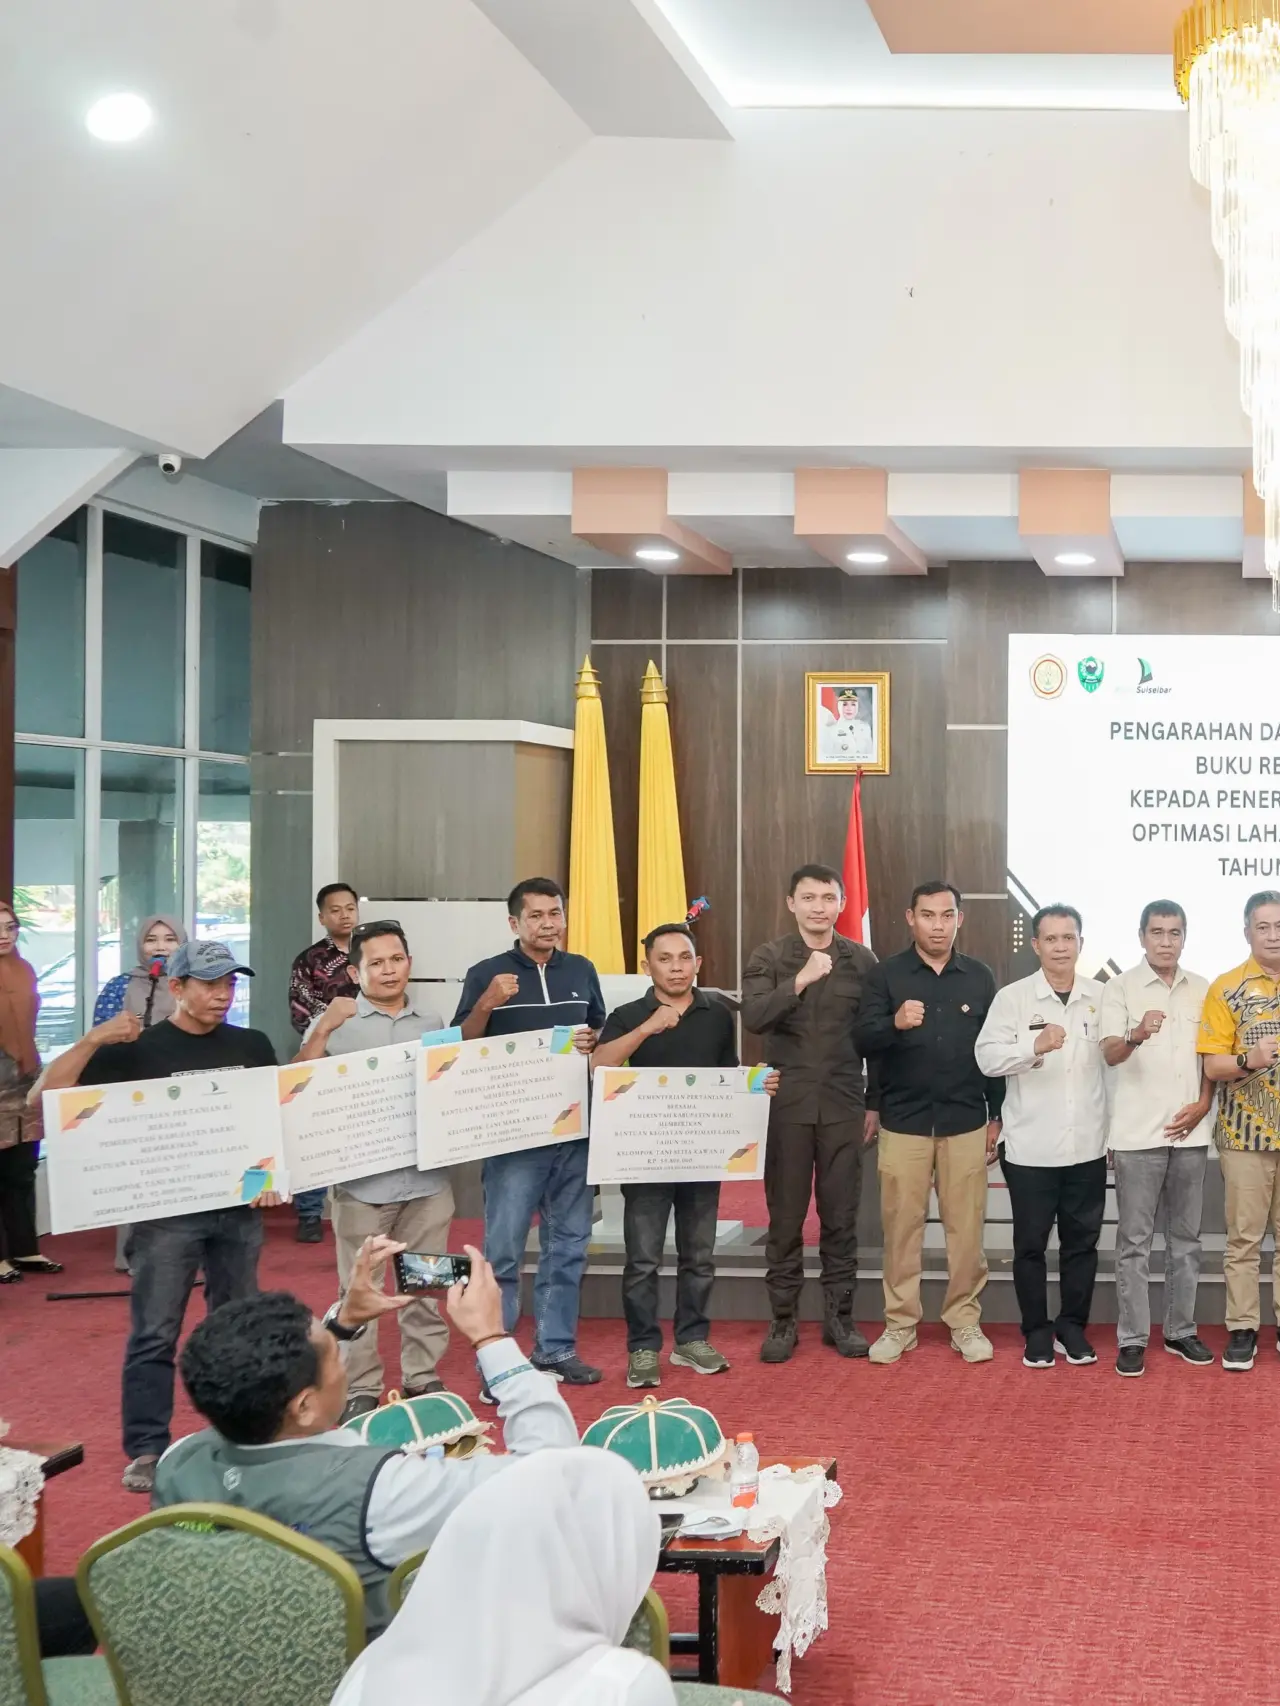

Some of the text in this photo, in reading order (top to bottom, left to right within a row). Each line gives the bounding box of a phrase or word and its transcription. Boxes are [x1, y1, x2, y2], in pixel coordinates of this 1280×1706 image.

[1110, 721, 1253, 741] PENGARAHAN
[1196, 756, 1252, 775] BUKU
[1130, 789, 1211, 808] KEPADA
[1132, 823, 1230, 843] OPTIMASI
[461, 1063, 506, 1075] KEMENTERIAN
[508, 1058, 543, 1068] PERTANIAN
[317, 1071, 413, 1096] KEMENTERIAN PERTANIAN
[454, 1084, 495, 1096] PEMERINTAH
[496, 1078, 533, 1089] KABUPATEN
[447, 1124, 481, 1136] KELOMPOK
